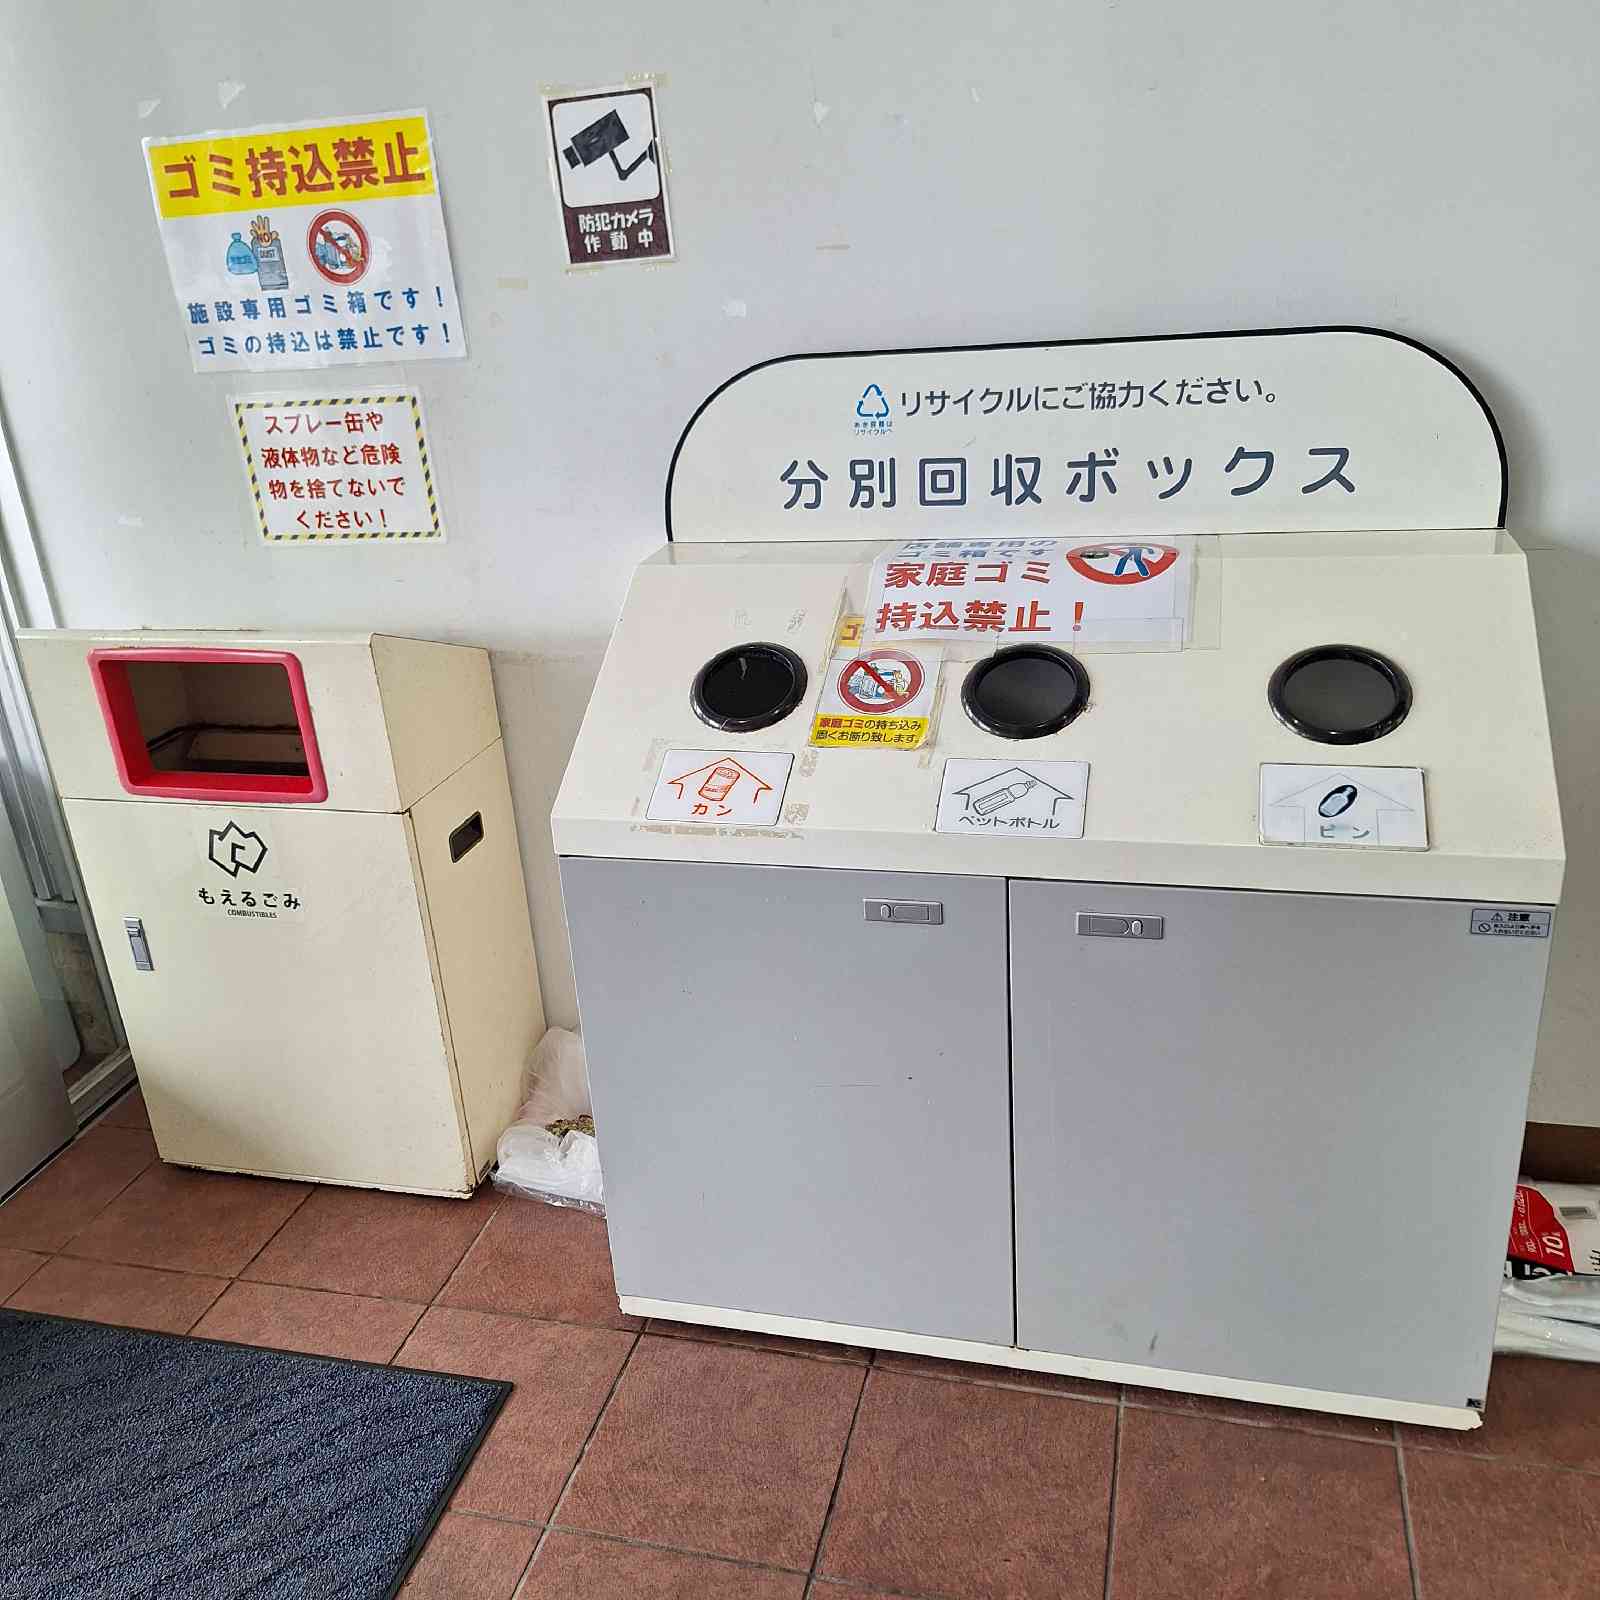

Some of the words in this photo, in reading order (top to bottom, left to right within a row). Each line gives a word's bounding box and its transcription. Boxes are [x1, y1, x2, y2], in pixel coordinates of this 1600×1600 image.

[164, 131, 426, 198] ゴミ持込禁止
[578, 207, 654, 234] 防犯カメラ
[584, 228, 654, 253] 作動中
[187, 286, 444, 324] 施設専用ゴミ箱です！
[198, 322, 450, 355] ゴミの持込は禁止です！
[901, 377, 1277, 416] リサイクルにご協力ください。
[264, 411, 384, 434] スプレー缶や
[261, 443, 402, 468] 液体物など危険
[268, 476, 406, 499] 物を捨てないで
[780, 446, 1356, 509] 分別回収ボックス
[296, 508, 388, 528] ください！
[884, 560, 1051, 588] 家庭ゴミ
[876, 600, 1085, 633] 持込禁止！
[820, 717, 922, 731] 家庭ゴミの持ち込み
[691, 803, 733, 817] カン
[958, 815, 1061, 830] ペットボトル
[197, 887, 302, 910] もえるごみ
[226, 908, 278, 919] COMBUSTIBLES
